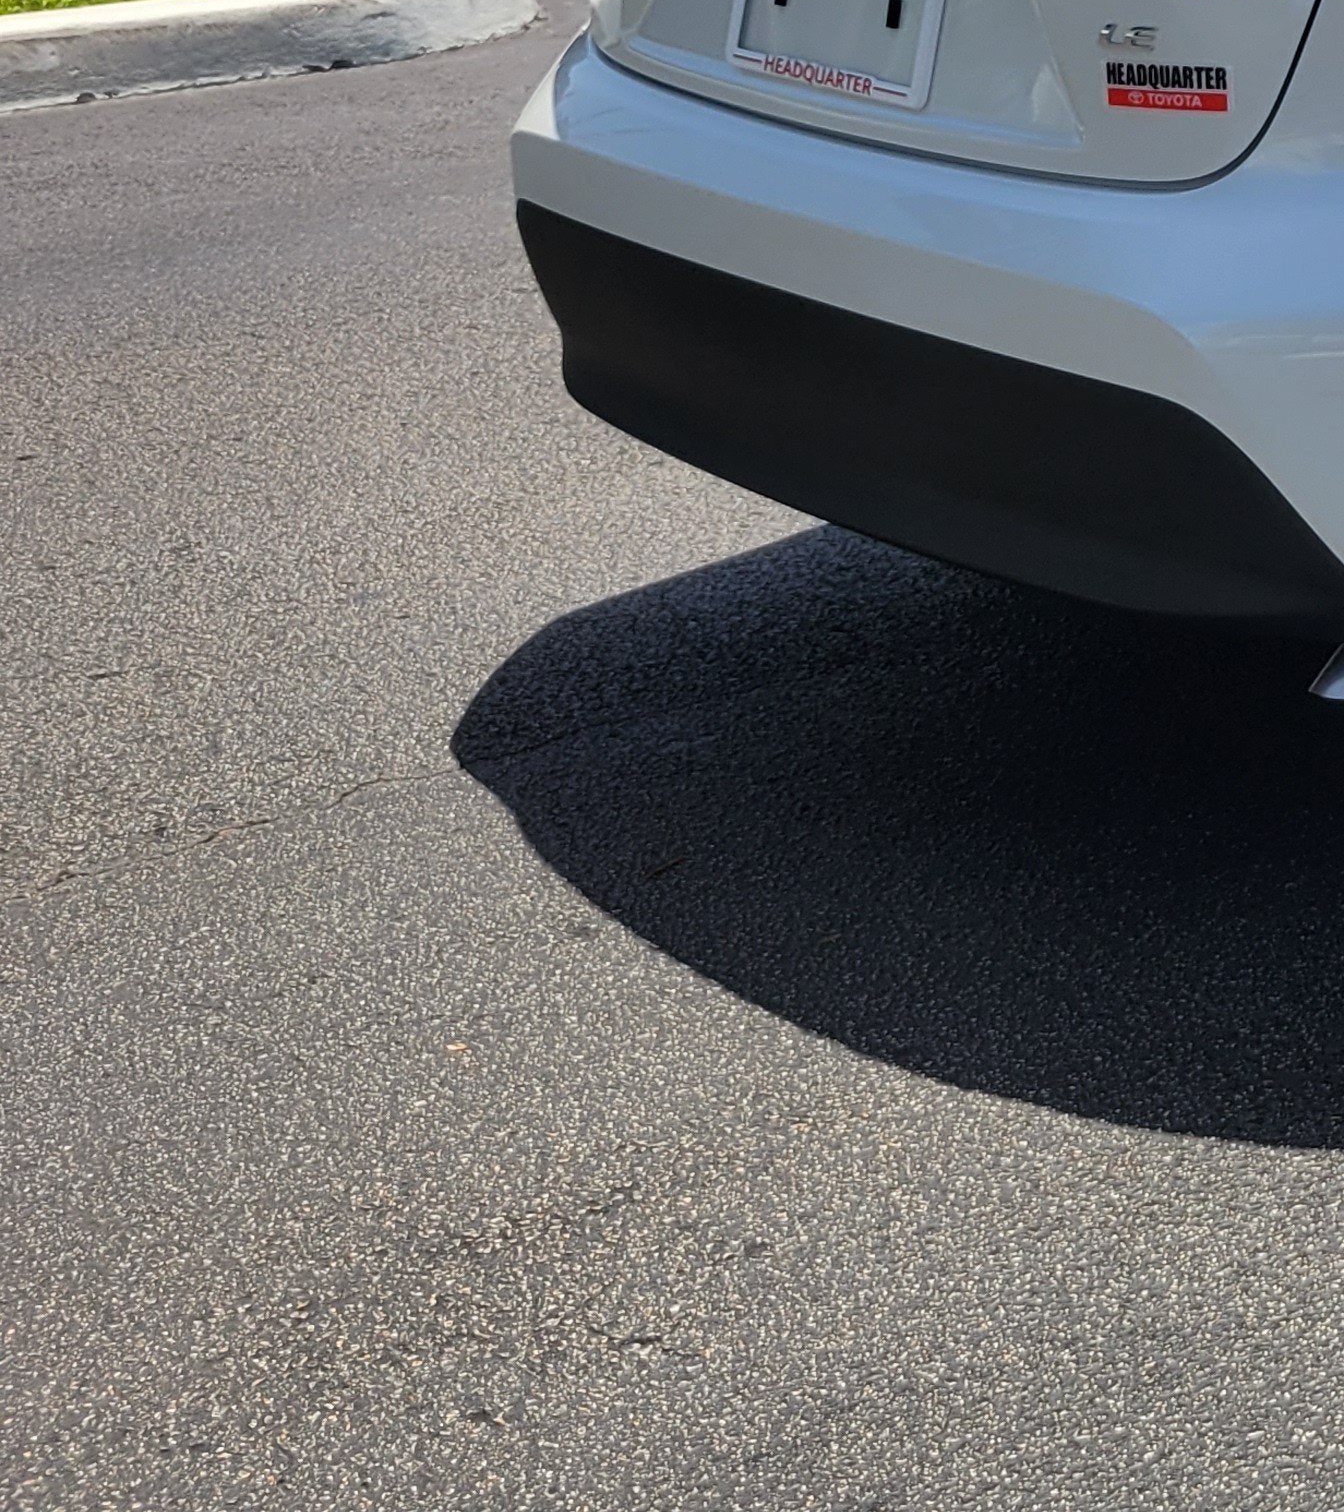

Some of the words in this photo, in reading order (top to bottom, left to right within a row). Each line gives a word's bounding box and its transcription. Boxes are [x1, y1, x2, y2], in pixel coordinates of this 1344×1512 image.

[1100, 23, 1158, 51] LE
[763, 54, 872, 97] HEADQUARTER
[1106, 61, 1228, 90] HEADQUARTER
[1146, 92, 1203, 108] TOYOTA
